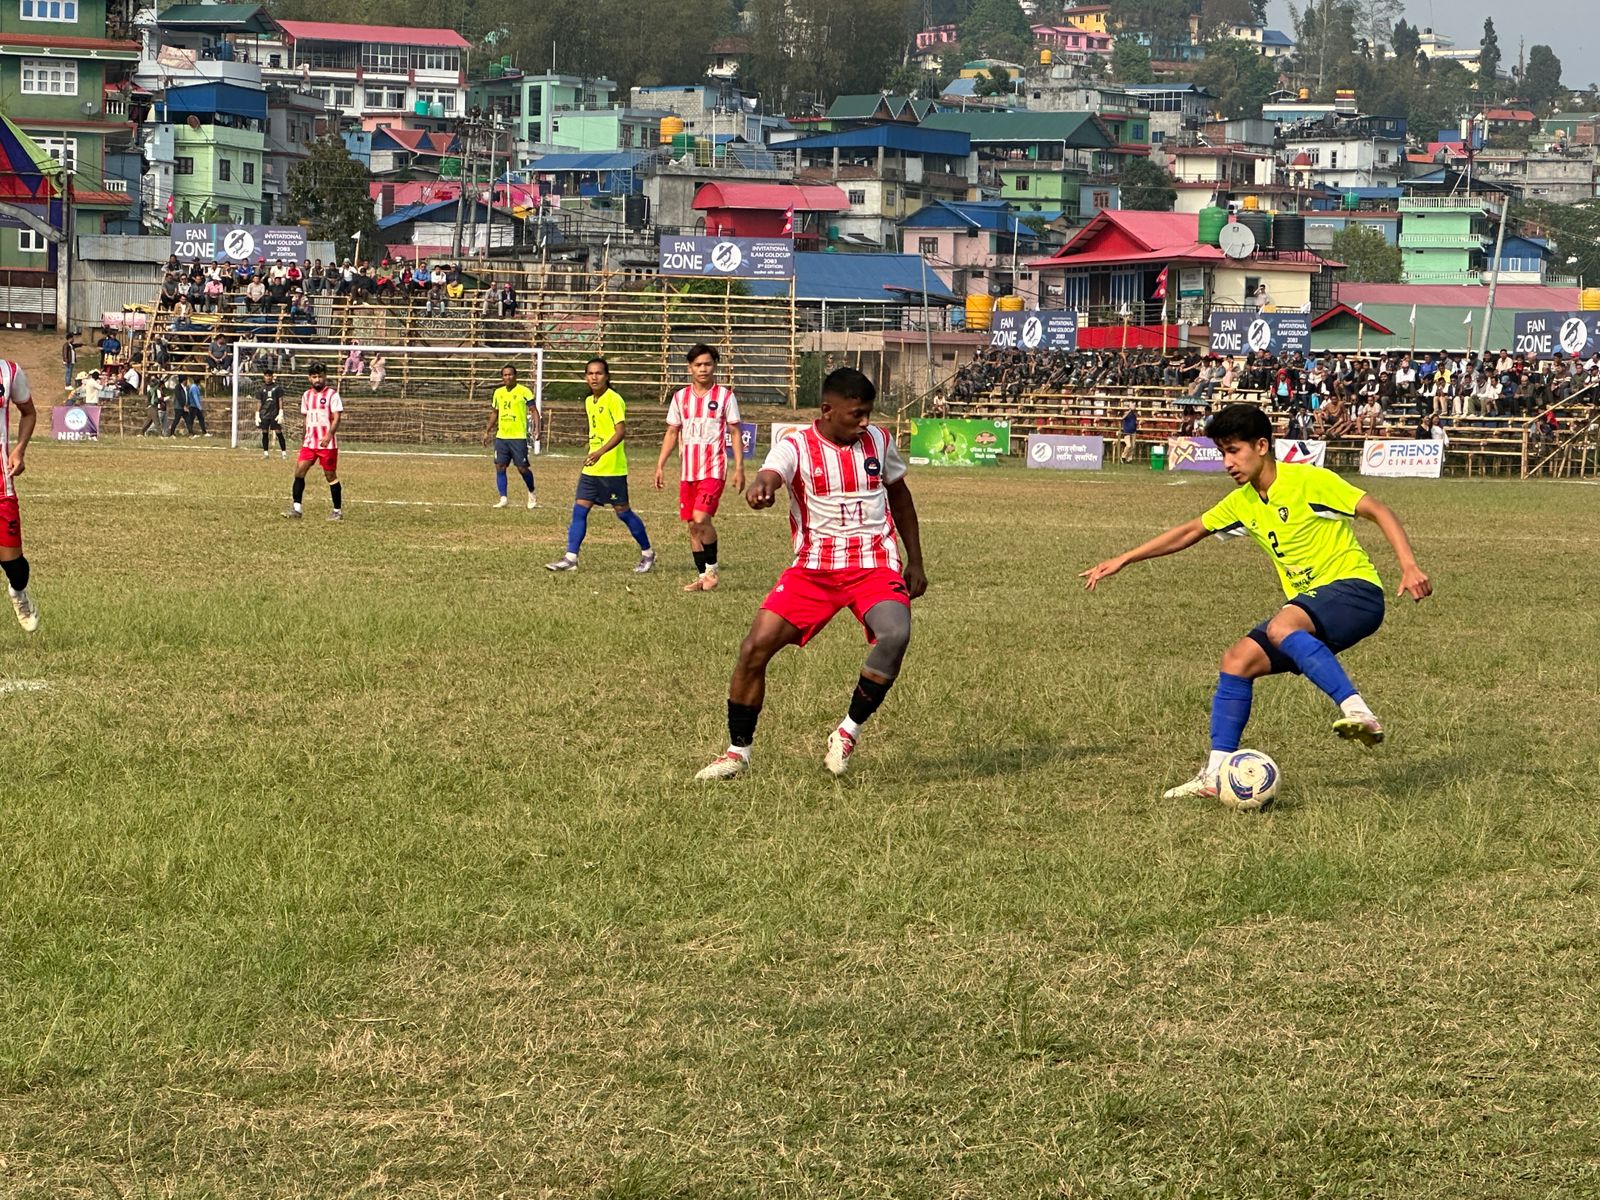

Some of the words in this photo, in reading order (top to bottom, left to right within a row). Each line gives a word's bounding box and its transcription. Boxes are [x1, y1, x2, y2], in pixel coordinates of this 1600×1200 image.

[186, 229, 207, 241] FAN
[174, 241, 215, 258] ZONE
[674, 241, 695, 252] FAN
[662, 253, 703, 270] ZONE
[1000, 317, 1014, 329] FAN
[1221, 319, 1237, 331] FAN
[1527, 319, 1546, 333] FAN
[991, 330, 1018, 346] ZONE
[1212, 333, 1242, 350] ZONE
[1516, 335, 1552, 353] ZONE
[503, 401, 512, 410] 24
[1389, 444, 1439, 456] FRIENDS
[1388, 458, 1438, 466] CINEMAS
[839, 500, 864, 526] M
[1268, 531, 1285, 558] 2
